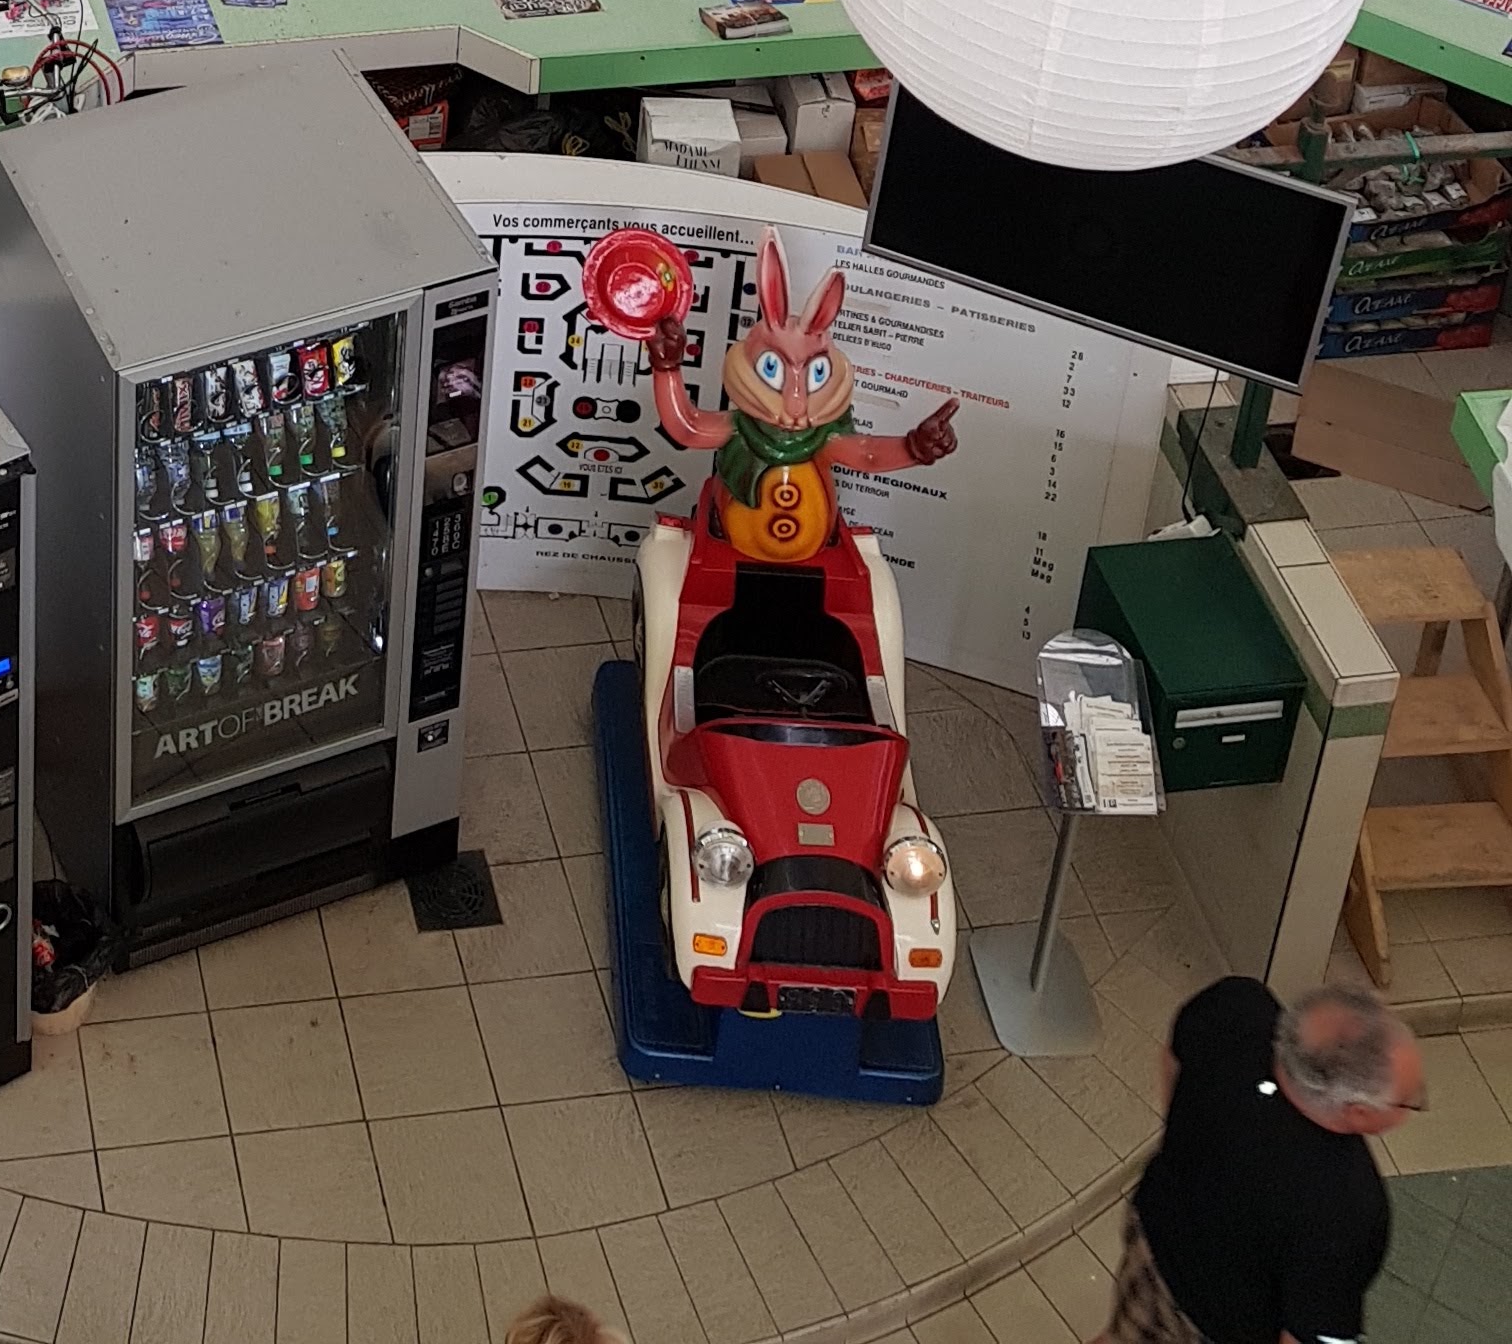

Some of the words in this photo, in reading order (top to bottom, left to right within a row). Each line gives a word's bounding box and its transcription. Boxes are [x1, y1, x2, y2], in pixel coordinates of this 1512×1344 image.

[493, 213, 519, 228] Vos
[522, 216, 619, 233] commerçants
[852, 262, 885, 277] HALLES
[886, 269, 946, 290] GOURMANDES
[878, 316, 945, 339] GOURMANDISES
[951, 304, 1036, 333] PATISSERIES
[833, 319, 861, 333] TELIER
[895, 331, 925, 347] PIERRE
[860, 380, 909, 399] GOURMAND
[884, 371, 952, 395] CHARCUTERIES
[960, 389, 1010, 409] TRAITEURS
[841, 480, 854, 491] DU
[854, 482, 890, 499] TERROIR
[873, 473, 948, 501] REGIONAUX
[536, 550, 558, 559] REZ
[562, 552, 576, 560] DE
[1033, 556, 1054, 572] Mag
[1031, 568, 1052, 584] Mag
[262, 672, 360, 725] BREAK
